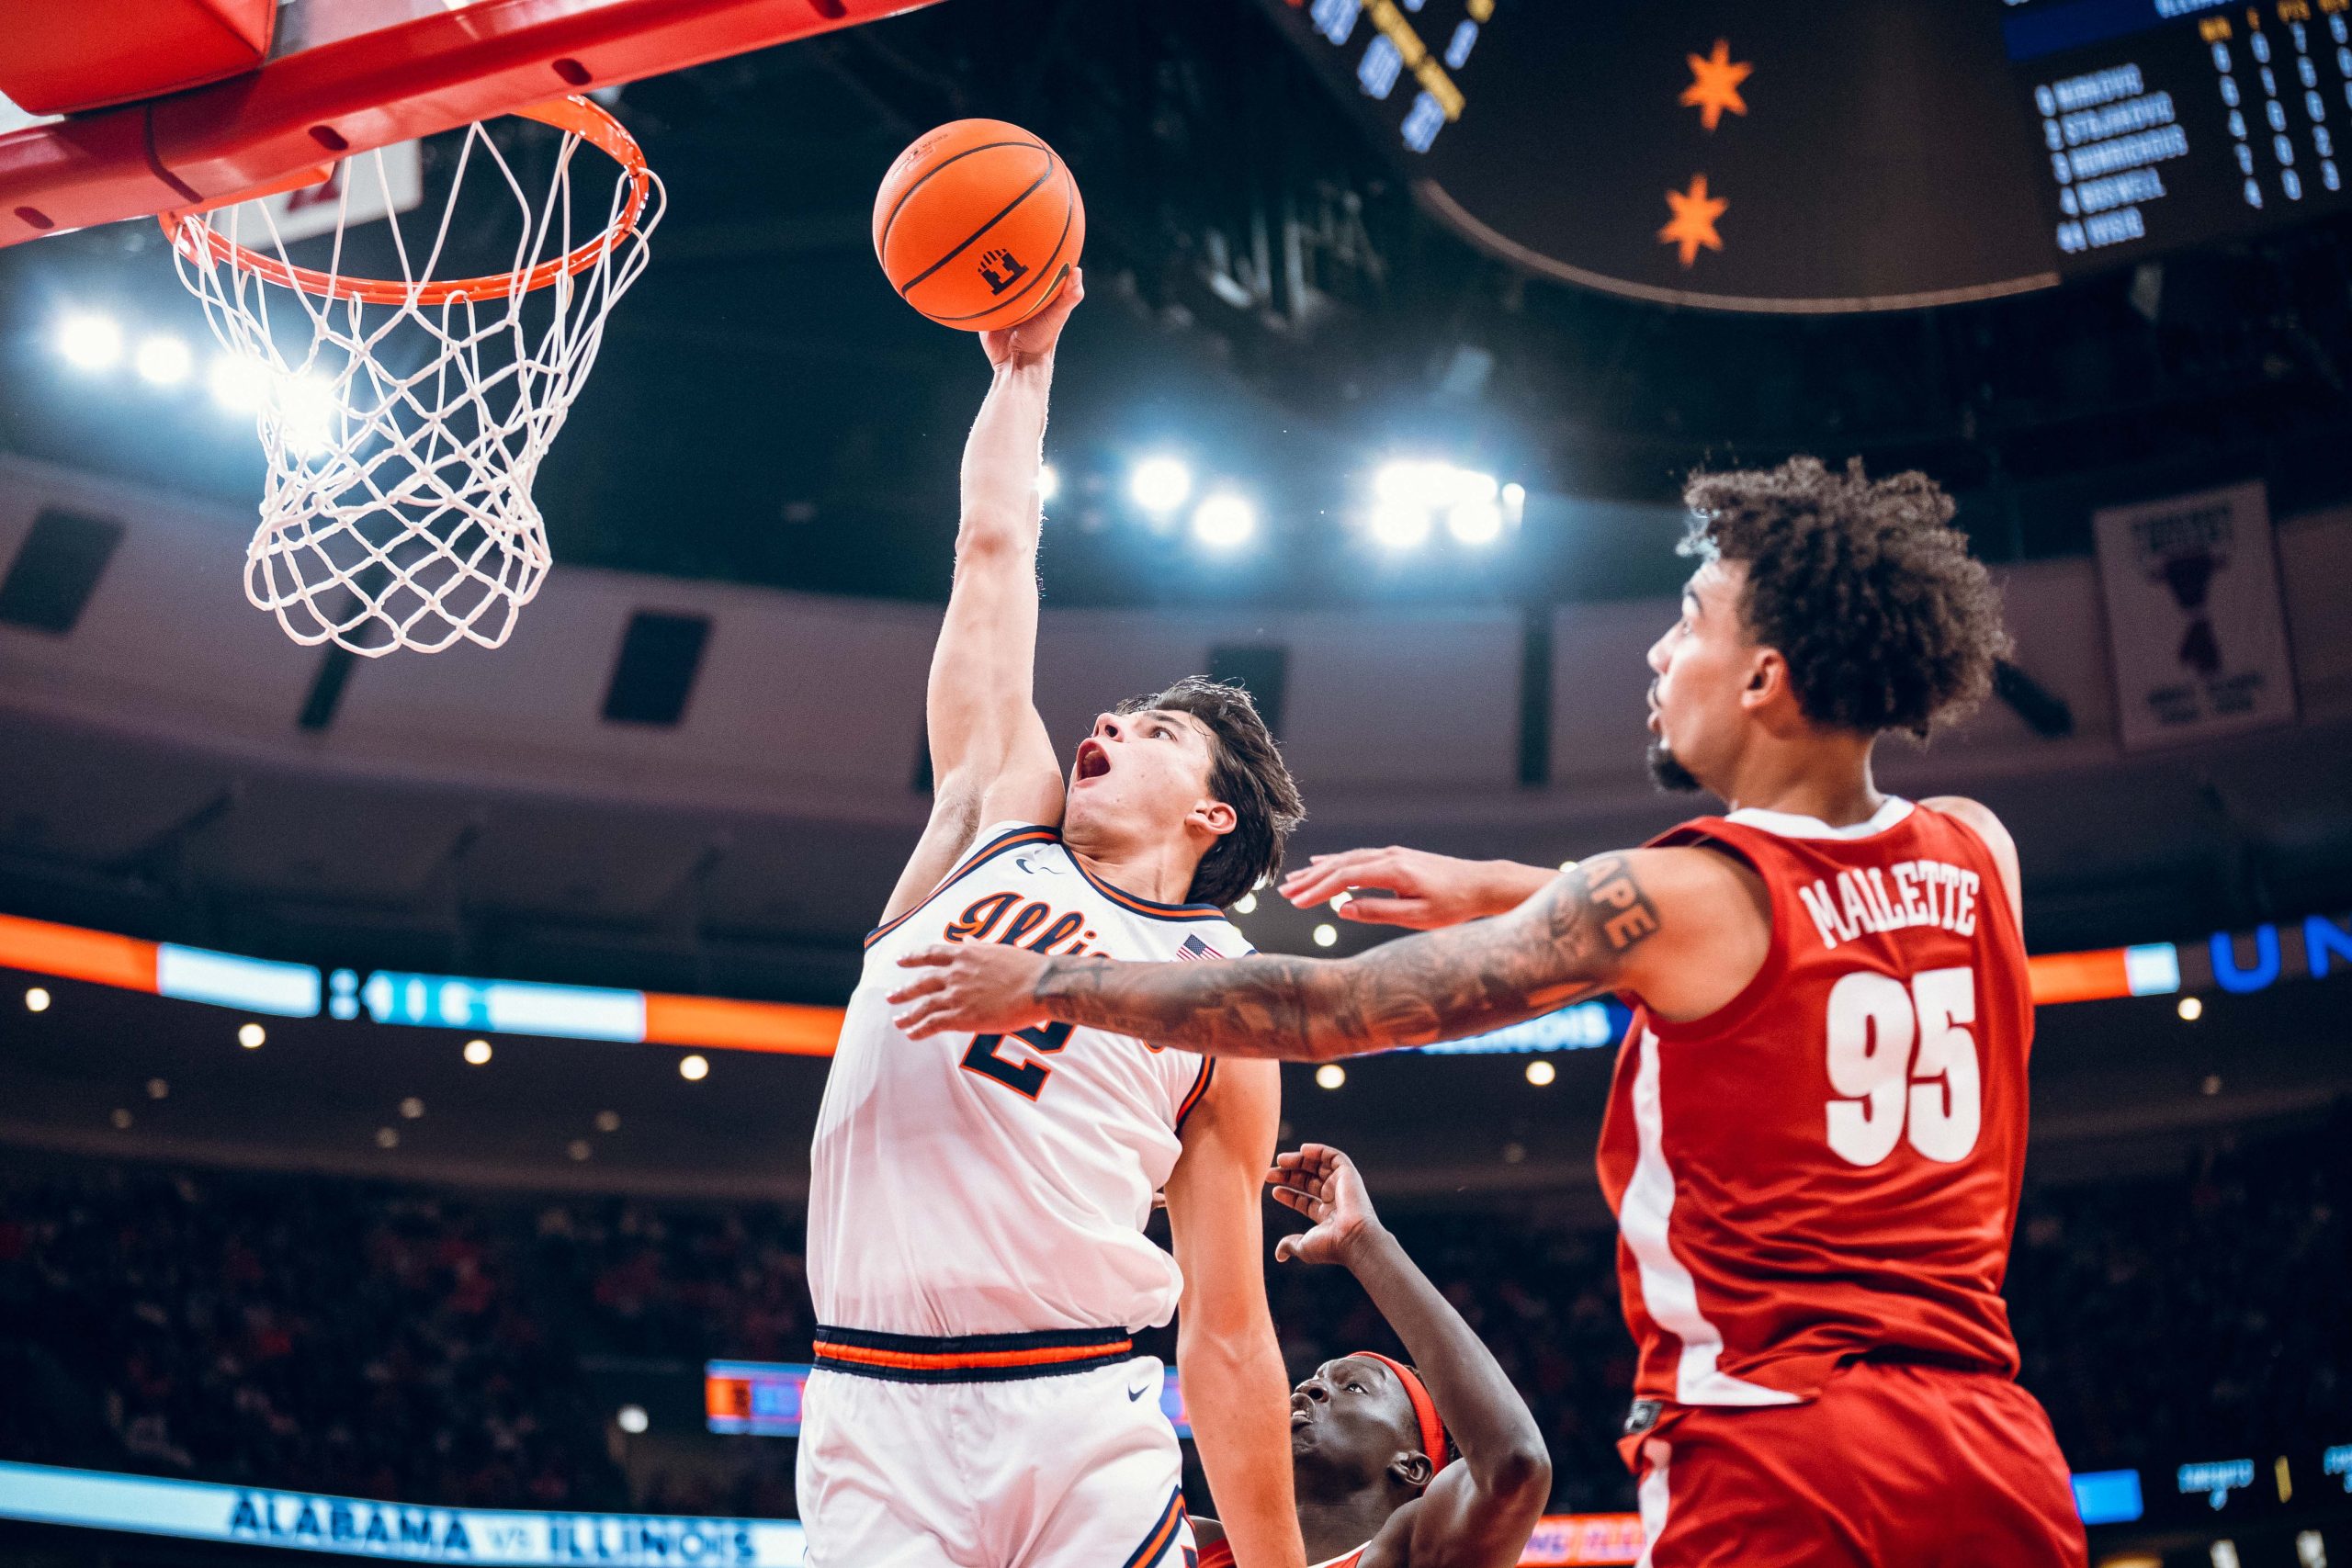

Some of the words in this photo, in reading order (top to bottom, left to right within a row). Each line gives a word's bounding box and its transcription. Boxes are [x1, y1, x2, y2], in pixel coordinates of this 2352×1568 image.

[944, 891, 1112, 958] Illi
[1799, 860, 1979, 949] MAILETTE
[1826, 966, 1981, 1167] 95
[231, 1498, 472, 1551] ALABAMA
[550, 1525, 755, 1560] ILLINOIS
